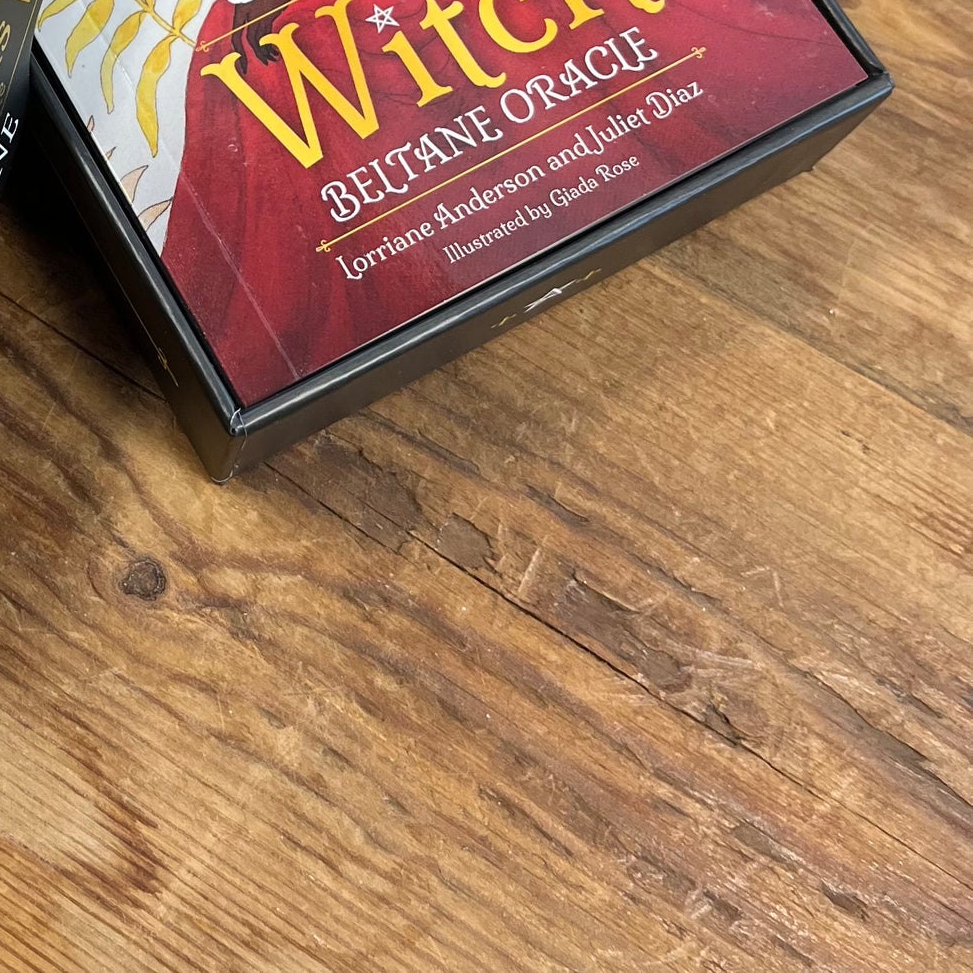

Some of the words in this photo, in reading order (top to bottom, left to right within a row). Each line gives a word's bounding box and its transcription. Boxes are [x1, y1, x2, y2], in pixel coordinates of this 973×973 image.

[321, 105, 504, 223] BELTANE
[499, 26, 659, 125] ORACLE
[335, 217, 435, 281] Lorriane
[432, 164, 543, 227] Anderson
[546, 133, 593, 171] and
[589, 106, 652, 156] Juliet
[646, 80, 704, 120] Diaz
[442, 209, 529, 265] Illustrated
[527, 200, 553, 221] by
[550, 174, 599, 208] Giada
[595, 153, 641, 183] Rose
